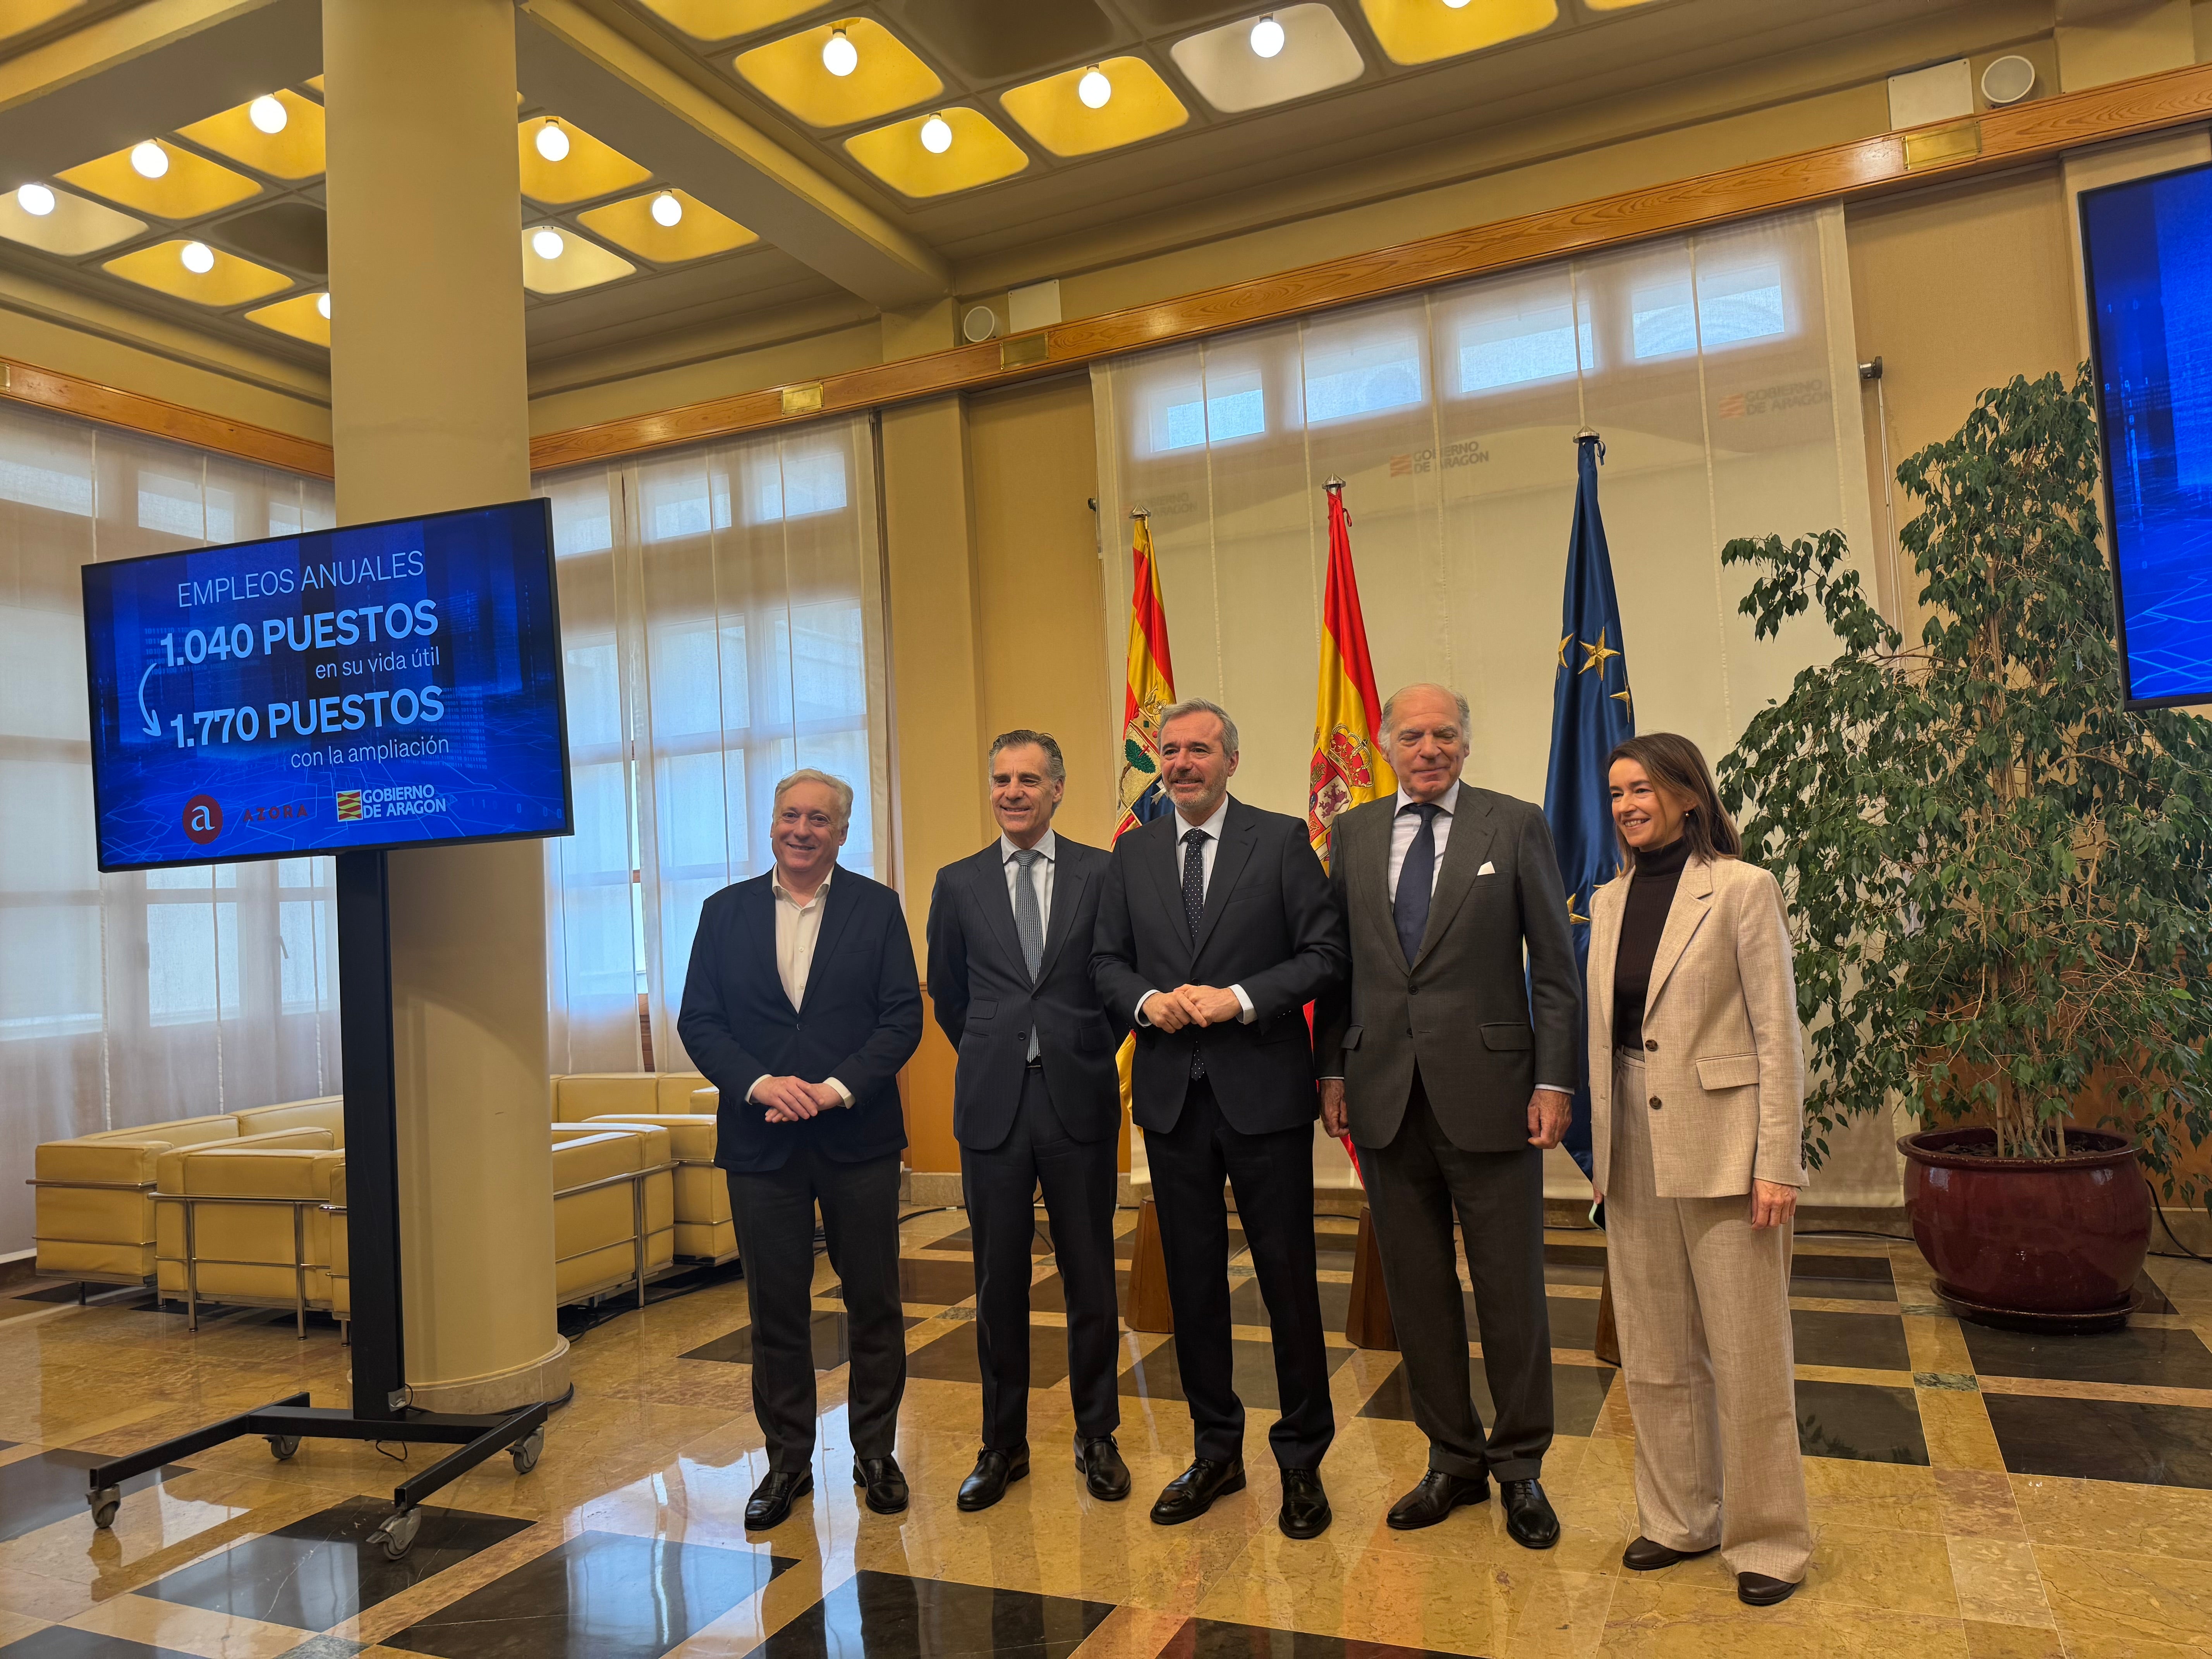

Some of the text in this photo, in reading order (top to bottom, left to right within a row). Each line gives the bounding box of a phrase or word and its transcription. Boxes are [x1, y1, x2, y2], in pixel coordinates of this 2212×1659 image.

[1413, 461, 1431, 474] DE
[179, 550, 424, 608] EMPLEOS ANUALES
[160, 623, 254, 667] 1.040
[263, 599, 438, 655] PUESTOS
[315, 646, 440, 679] en su vida útil
[170, 685, 445, 748] 1.770 PUESTOS
[291, 751, 323, 768] con
[328, 745, 344, 764] la
[348, 735, 449, 764] ampliación
[362, 784, 435, 804] GOBIERNO
[363, 798, 447, 819] DE ARAGON
[191, 804, 309, 832] a AZORA
